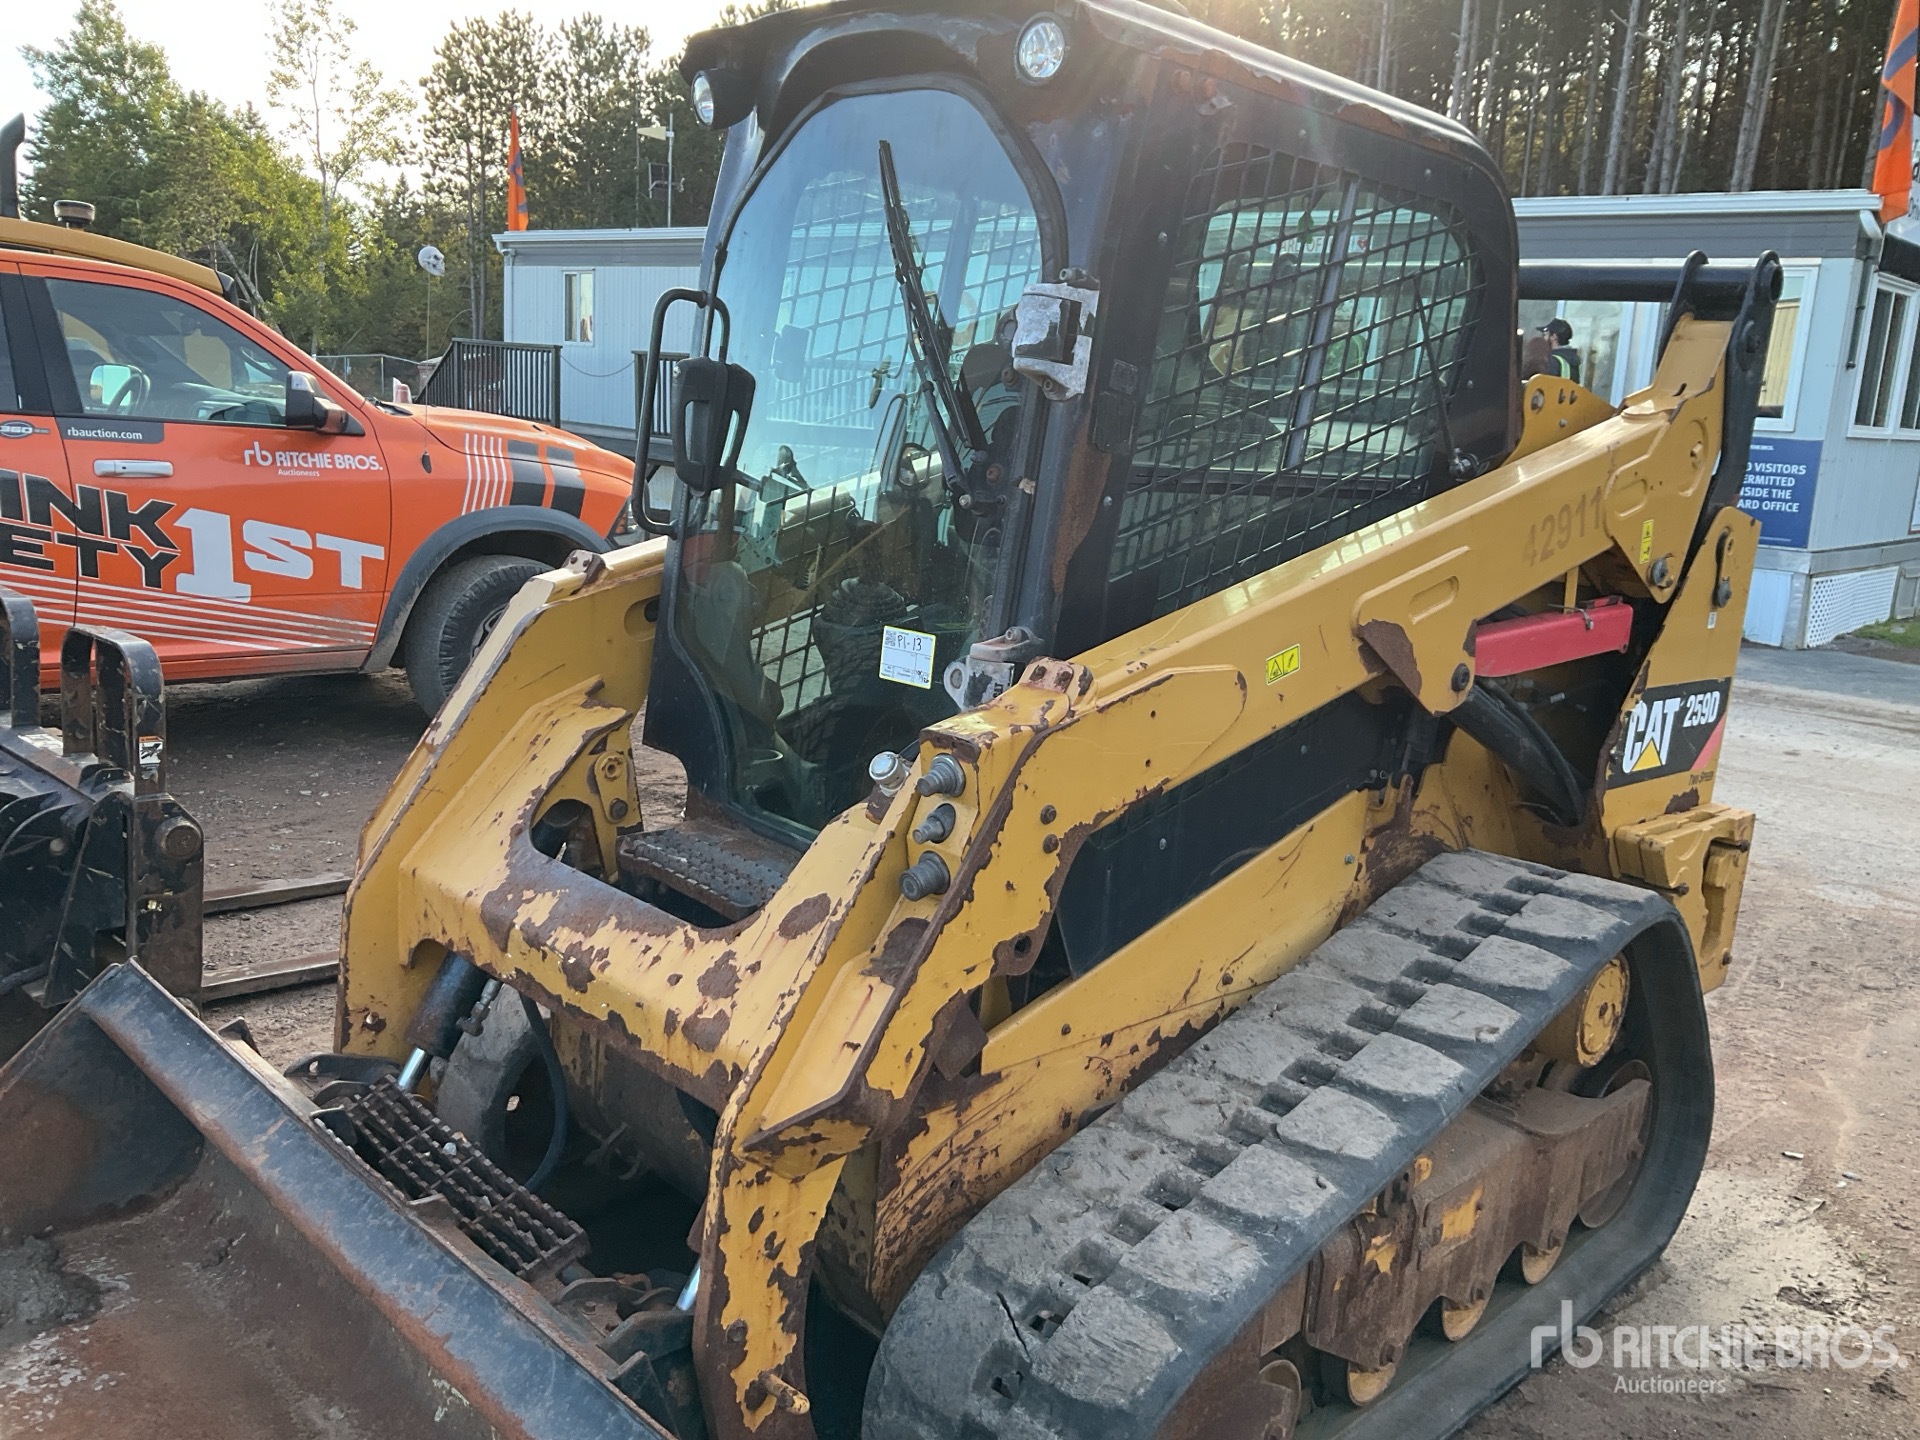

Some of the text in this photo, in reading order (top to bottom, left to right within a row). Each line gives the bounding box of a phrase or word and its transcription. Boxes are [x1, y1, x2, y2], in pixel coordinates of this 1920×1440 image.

[67, 426, 143, 440] rbauction.com
[275, 451, 333, 468] RITCHIE
[334, 453, 383, 470] BROS.
[1754, 462, 1807, 474] VISITORS
[278, 468, 320, 477] Auctioneers
[1743, 474, 1795, 486] ERMITTED
[1771, 489, 1792, 499] THE
[0, 468, 181, 551] INK
[1737, 499, 1800, 512] ARD OFFICE
[1523, 485, 1601, 567] 42911
[0, 521, 181, 590] ETY
[173, 507, 385, 603] 1ST
[1622, 690, 1720, 774] CAT 259D
